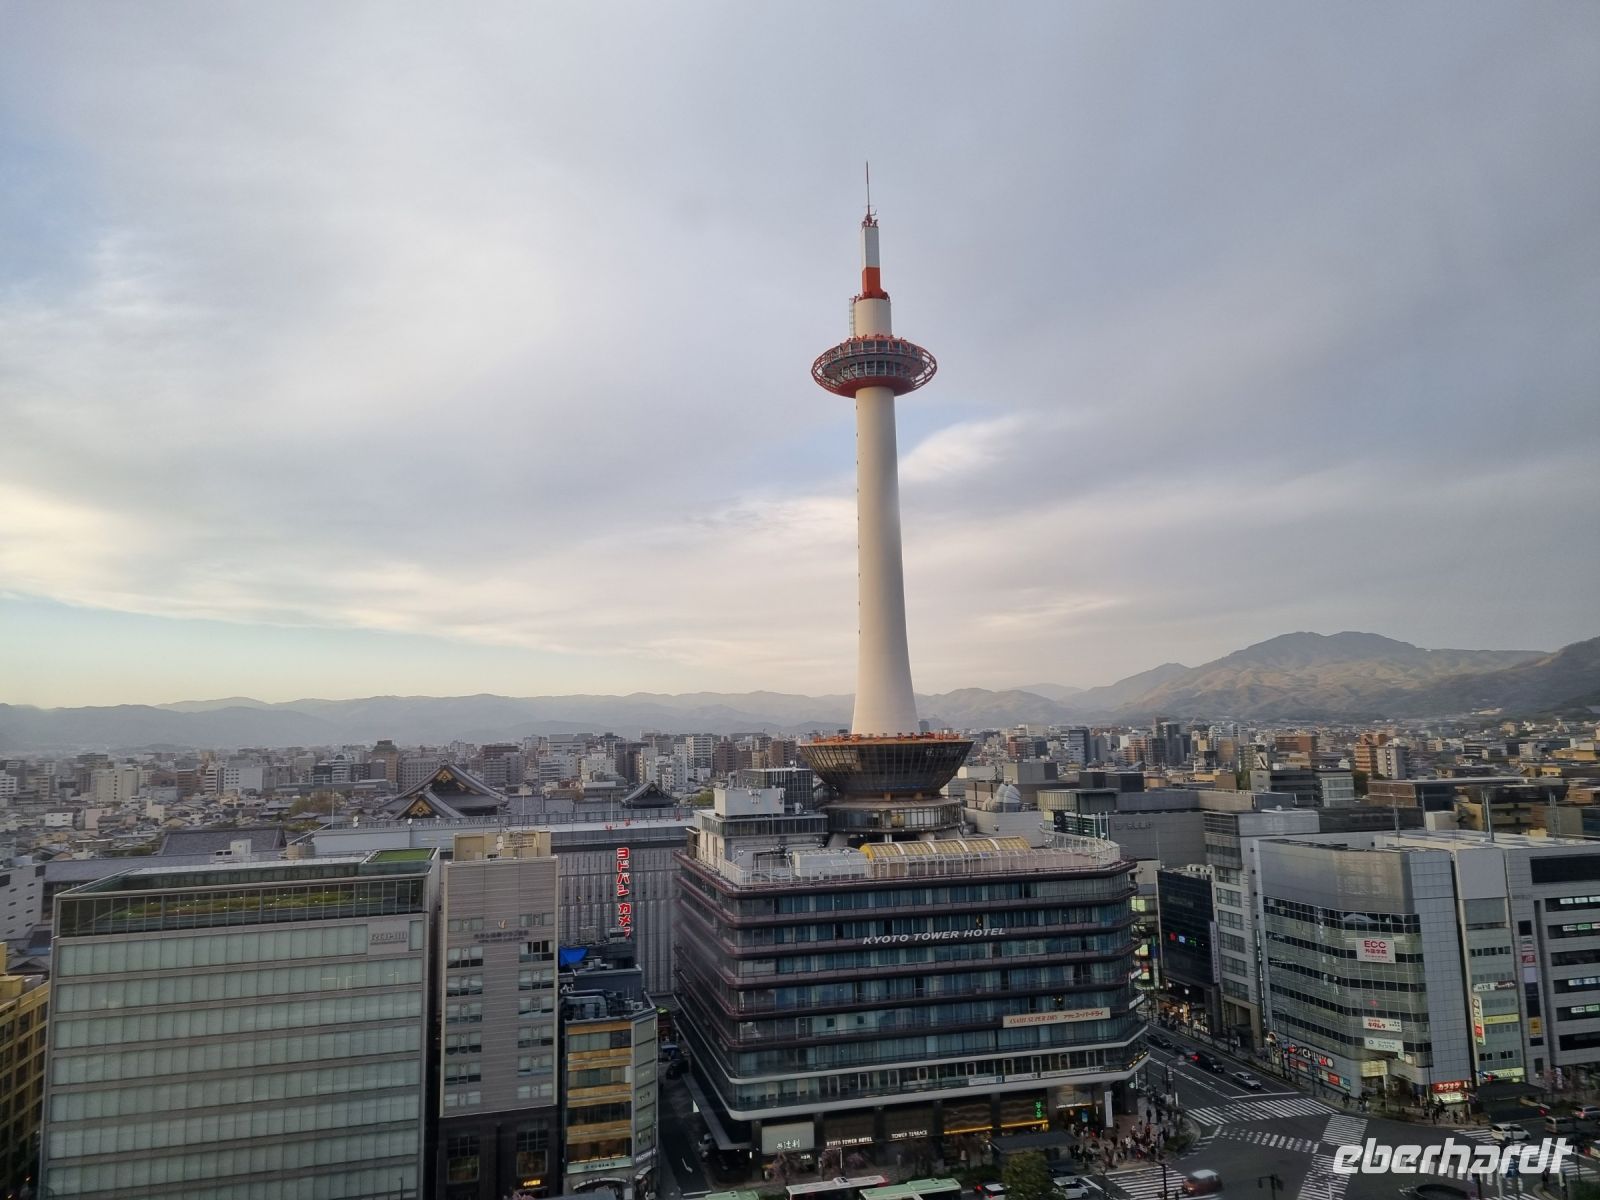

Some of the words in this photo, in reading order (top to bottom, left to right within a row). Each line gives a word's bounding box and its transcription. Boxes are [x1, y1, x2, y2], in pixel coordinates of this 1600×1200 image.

[616, 847, 630, 896] ヨドバシ
[863, 935, 909, 944] KYOTO
[914, 931, 959, 940] TOWER
[964, 928, 1006, 937] HOTEL
[1364, 940, 1386, 949] ECC
